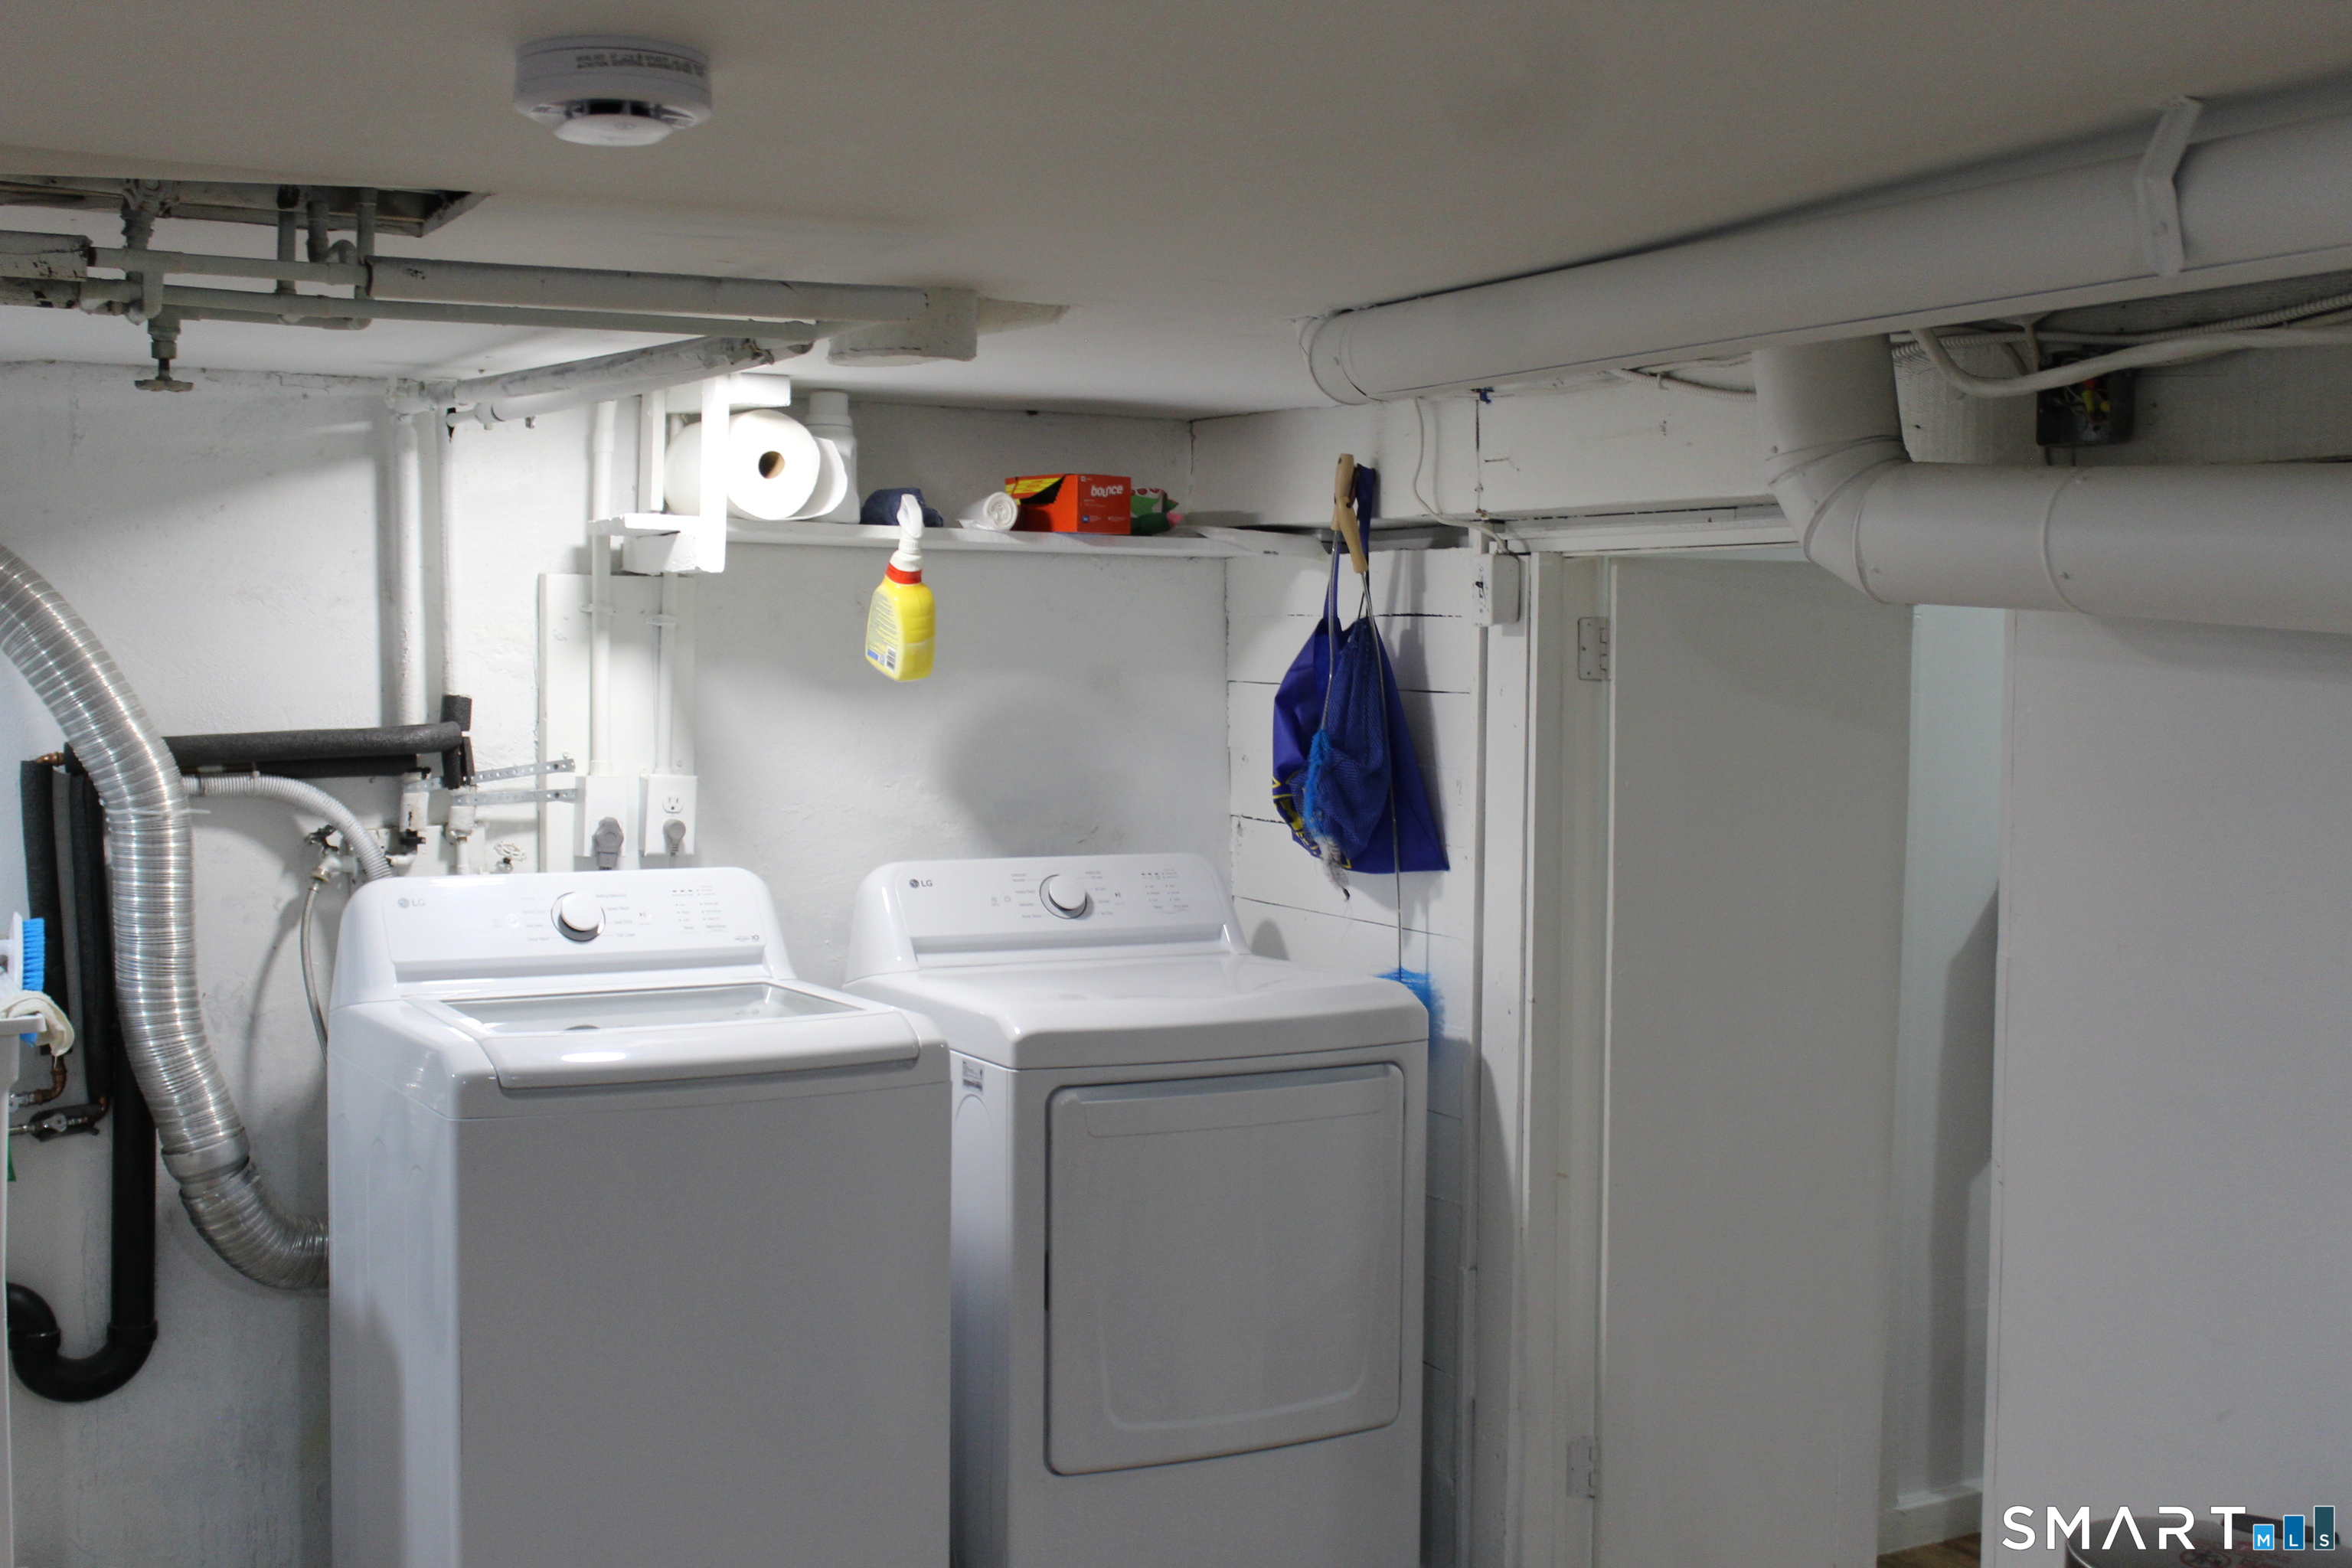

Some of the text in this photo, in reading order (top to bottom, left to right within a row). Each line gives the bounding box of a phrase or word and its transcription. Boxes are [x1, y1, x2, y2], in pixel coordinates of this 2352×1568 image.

[1090, 484, 1124, 498] bounce
[920, 879, 933, 887] LG
[411, 898, 426, 906] LG
